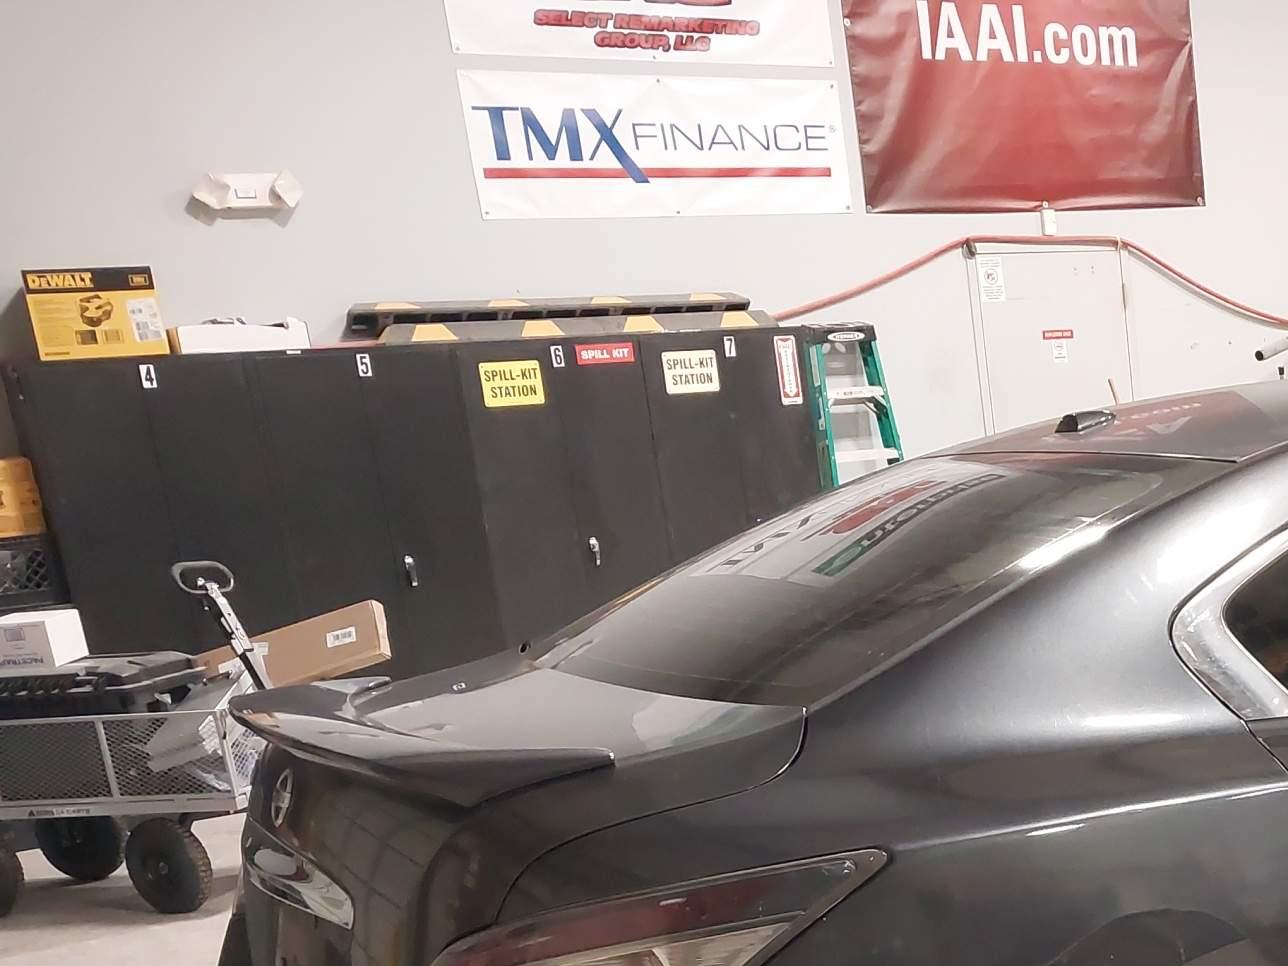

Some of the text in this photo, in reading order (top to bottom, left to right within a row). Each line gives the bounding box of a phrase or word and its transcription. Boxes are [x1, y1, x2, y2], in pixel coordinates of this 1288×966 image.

[534, 9, 760, 35] SELECT REMARKETING
[594, 31, 711, 52] GROUP, LLC
[916, 0, 1139, 67] IAAI.com
[471, 106, 829, 184] TMX FINANCE
[553, 346, 563, 366] 6
[580, 348, 630, 361] SPILL KIT
[725, 338, 734, 356] 7
[359, 355, 369, 375] 5
[666, 357, 714, 371] SPILL-KIT
[145, 365, 154, 387] 4
[483, 367, 539, 382] SPILL-KIT
[672, 373, 713, 386] STATION
[490, 384, 537, 399] STATION
